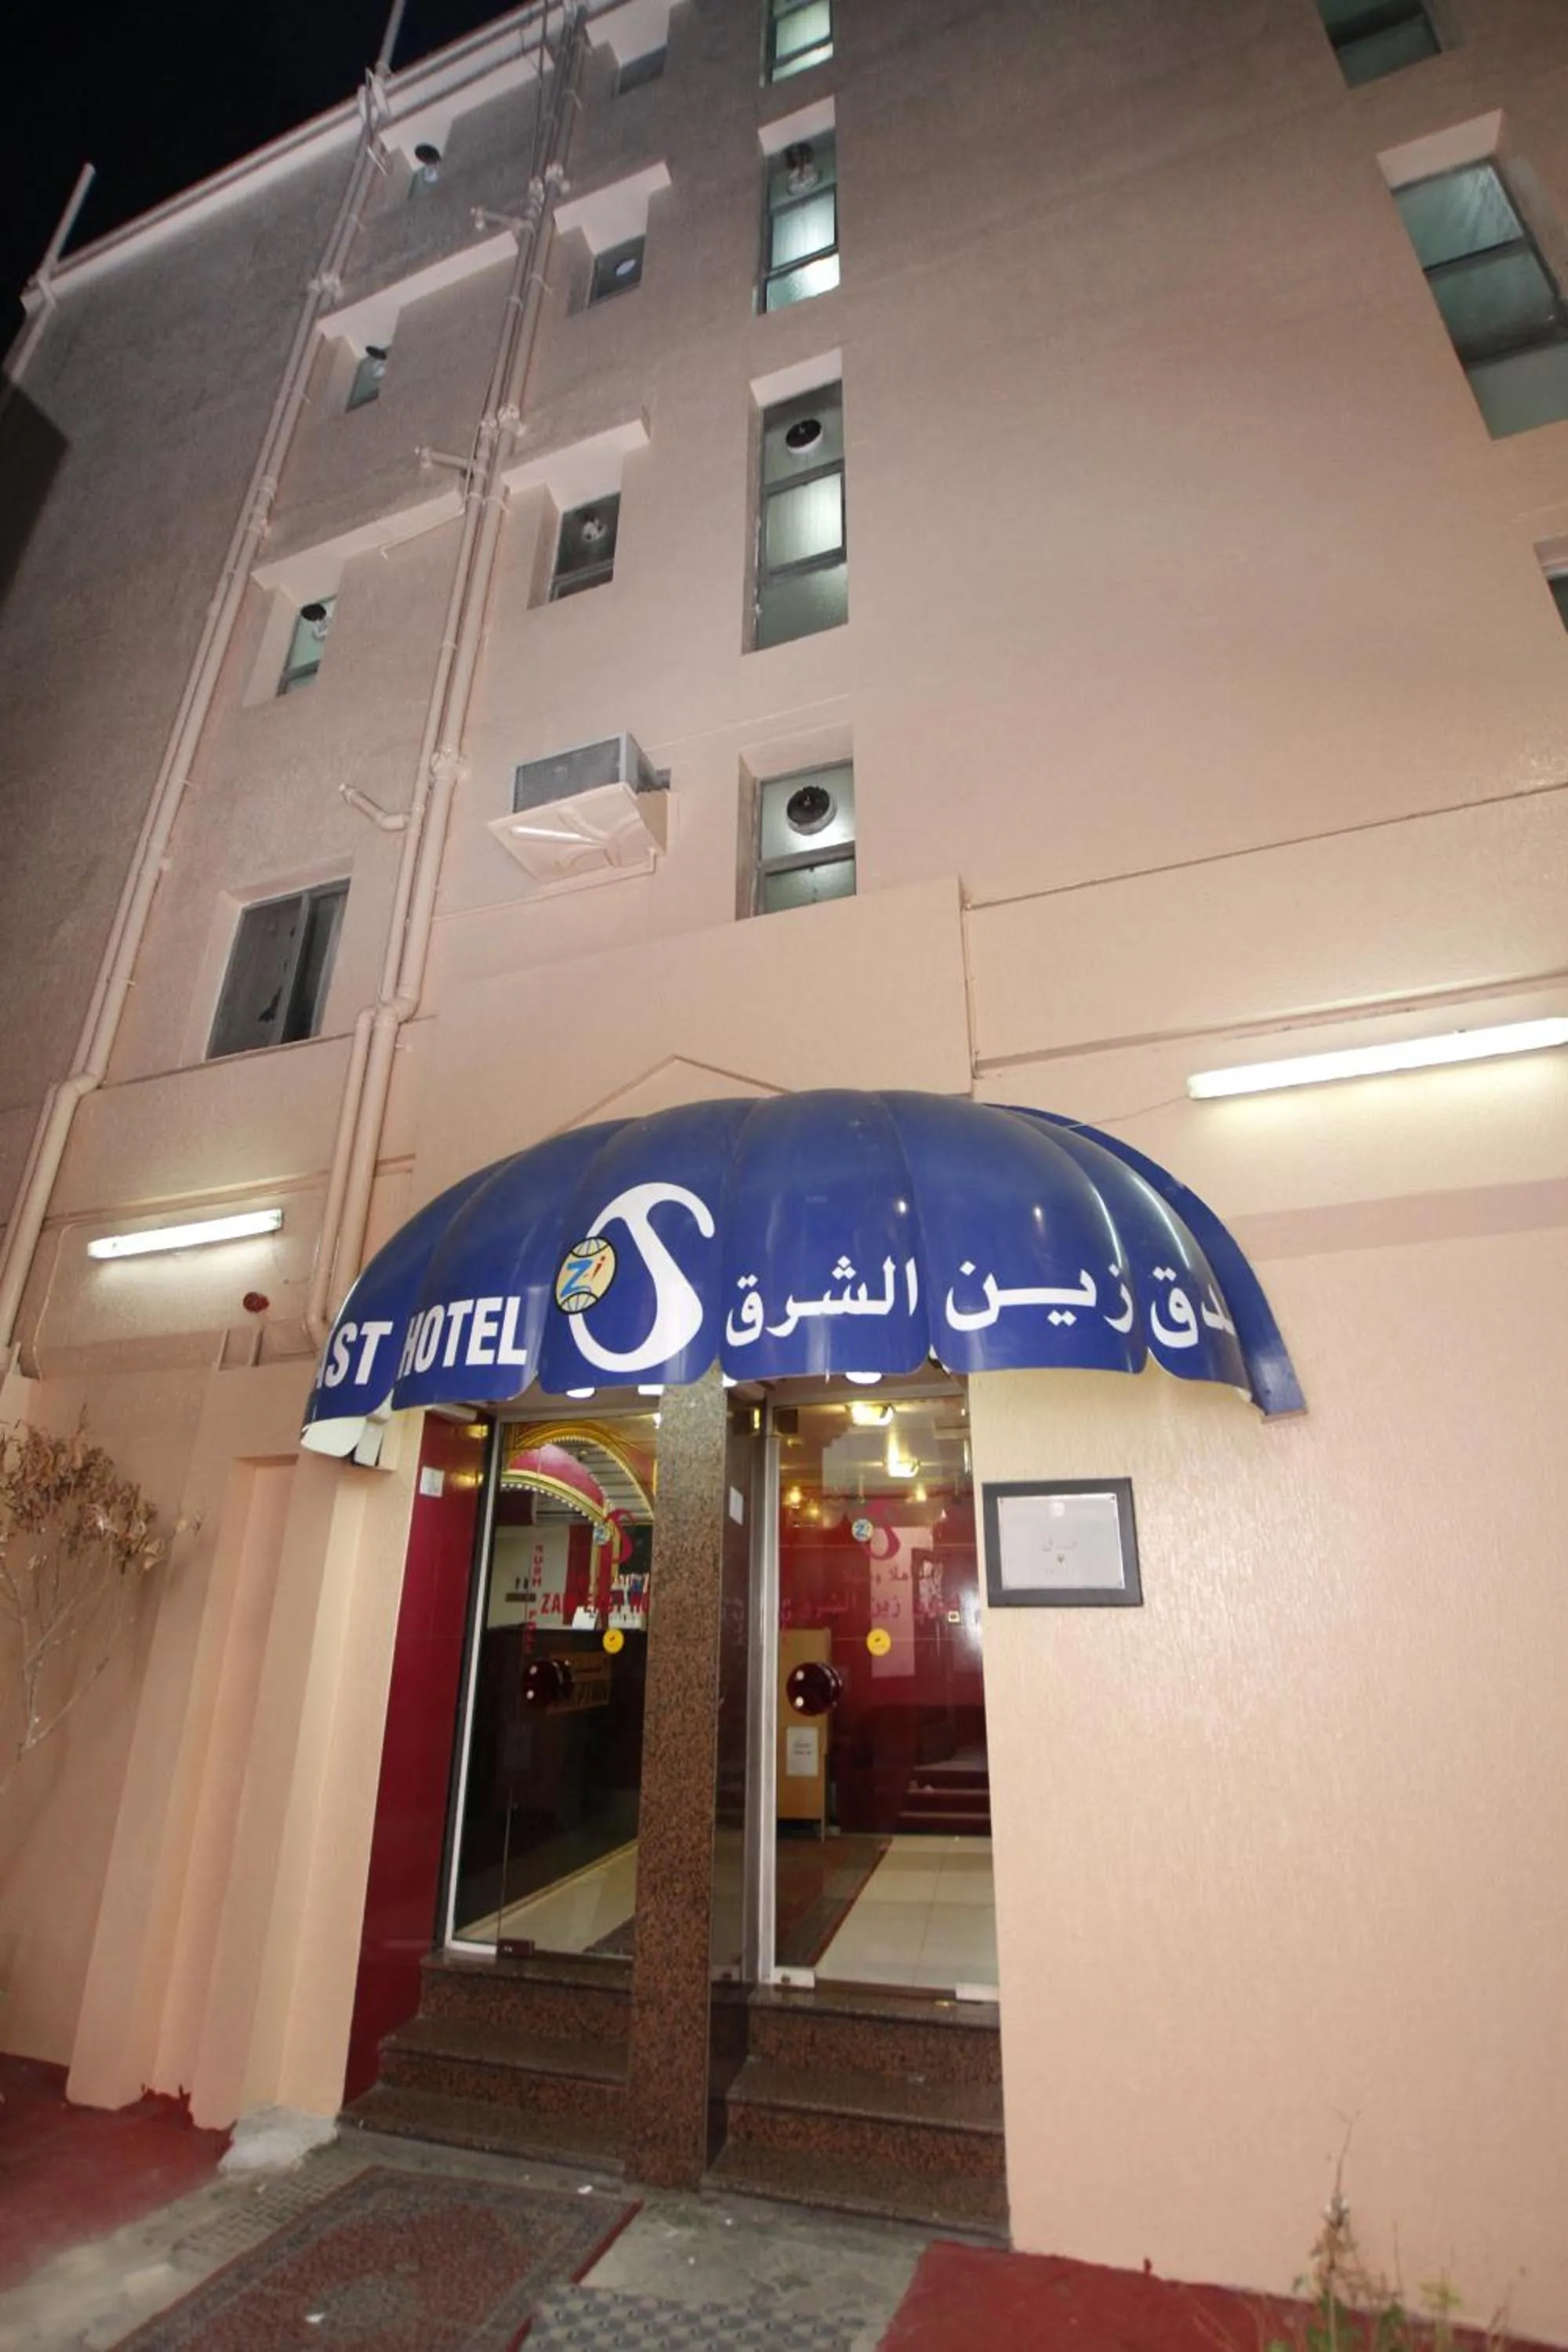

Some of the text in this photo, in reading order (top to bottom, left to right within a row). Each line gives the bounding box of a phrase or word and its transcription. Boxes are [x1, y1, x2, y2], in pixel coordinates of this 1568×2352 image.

[396, 1296, 528, 1381] HOTEL
[725, 1254, 918, 1347] الشرق
[945, 1258, 1134, 1334] زين
